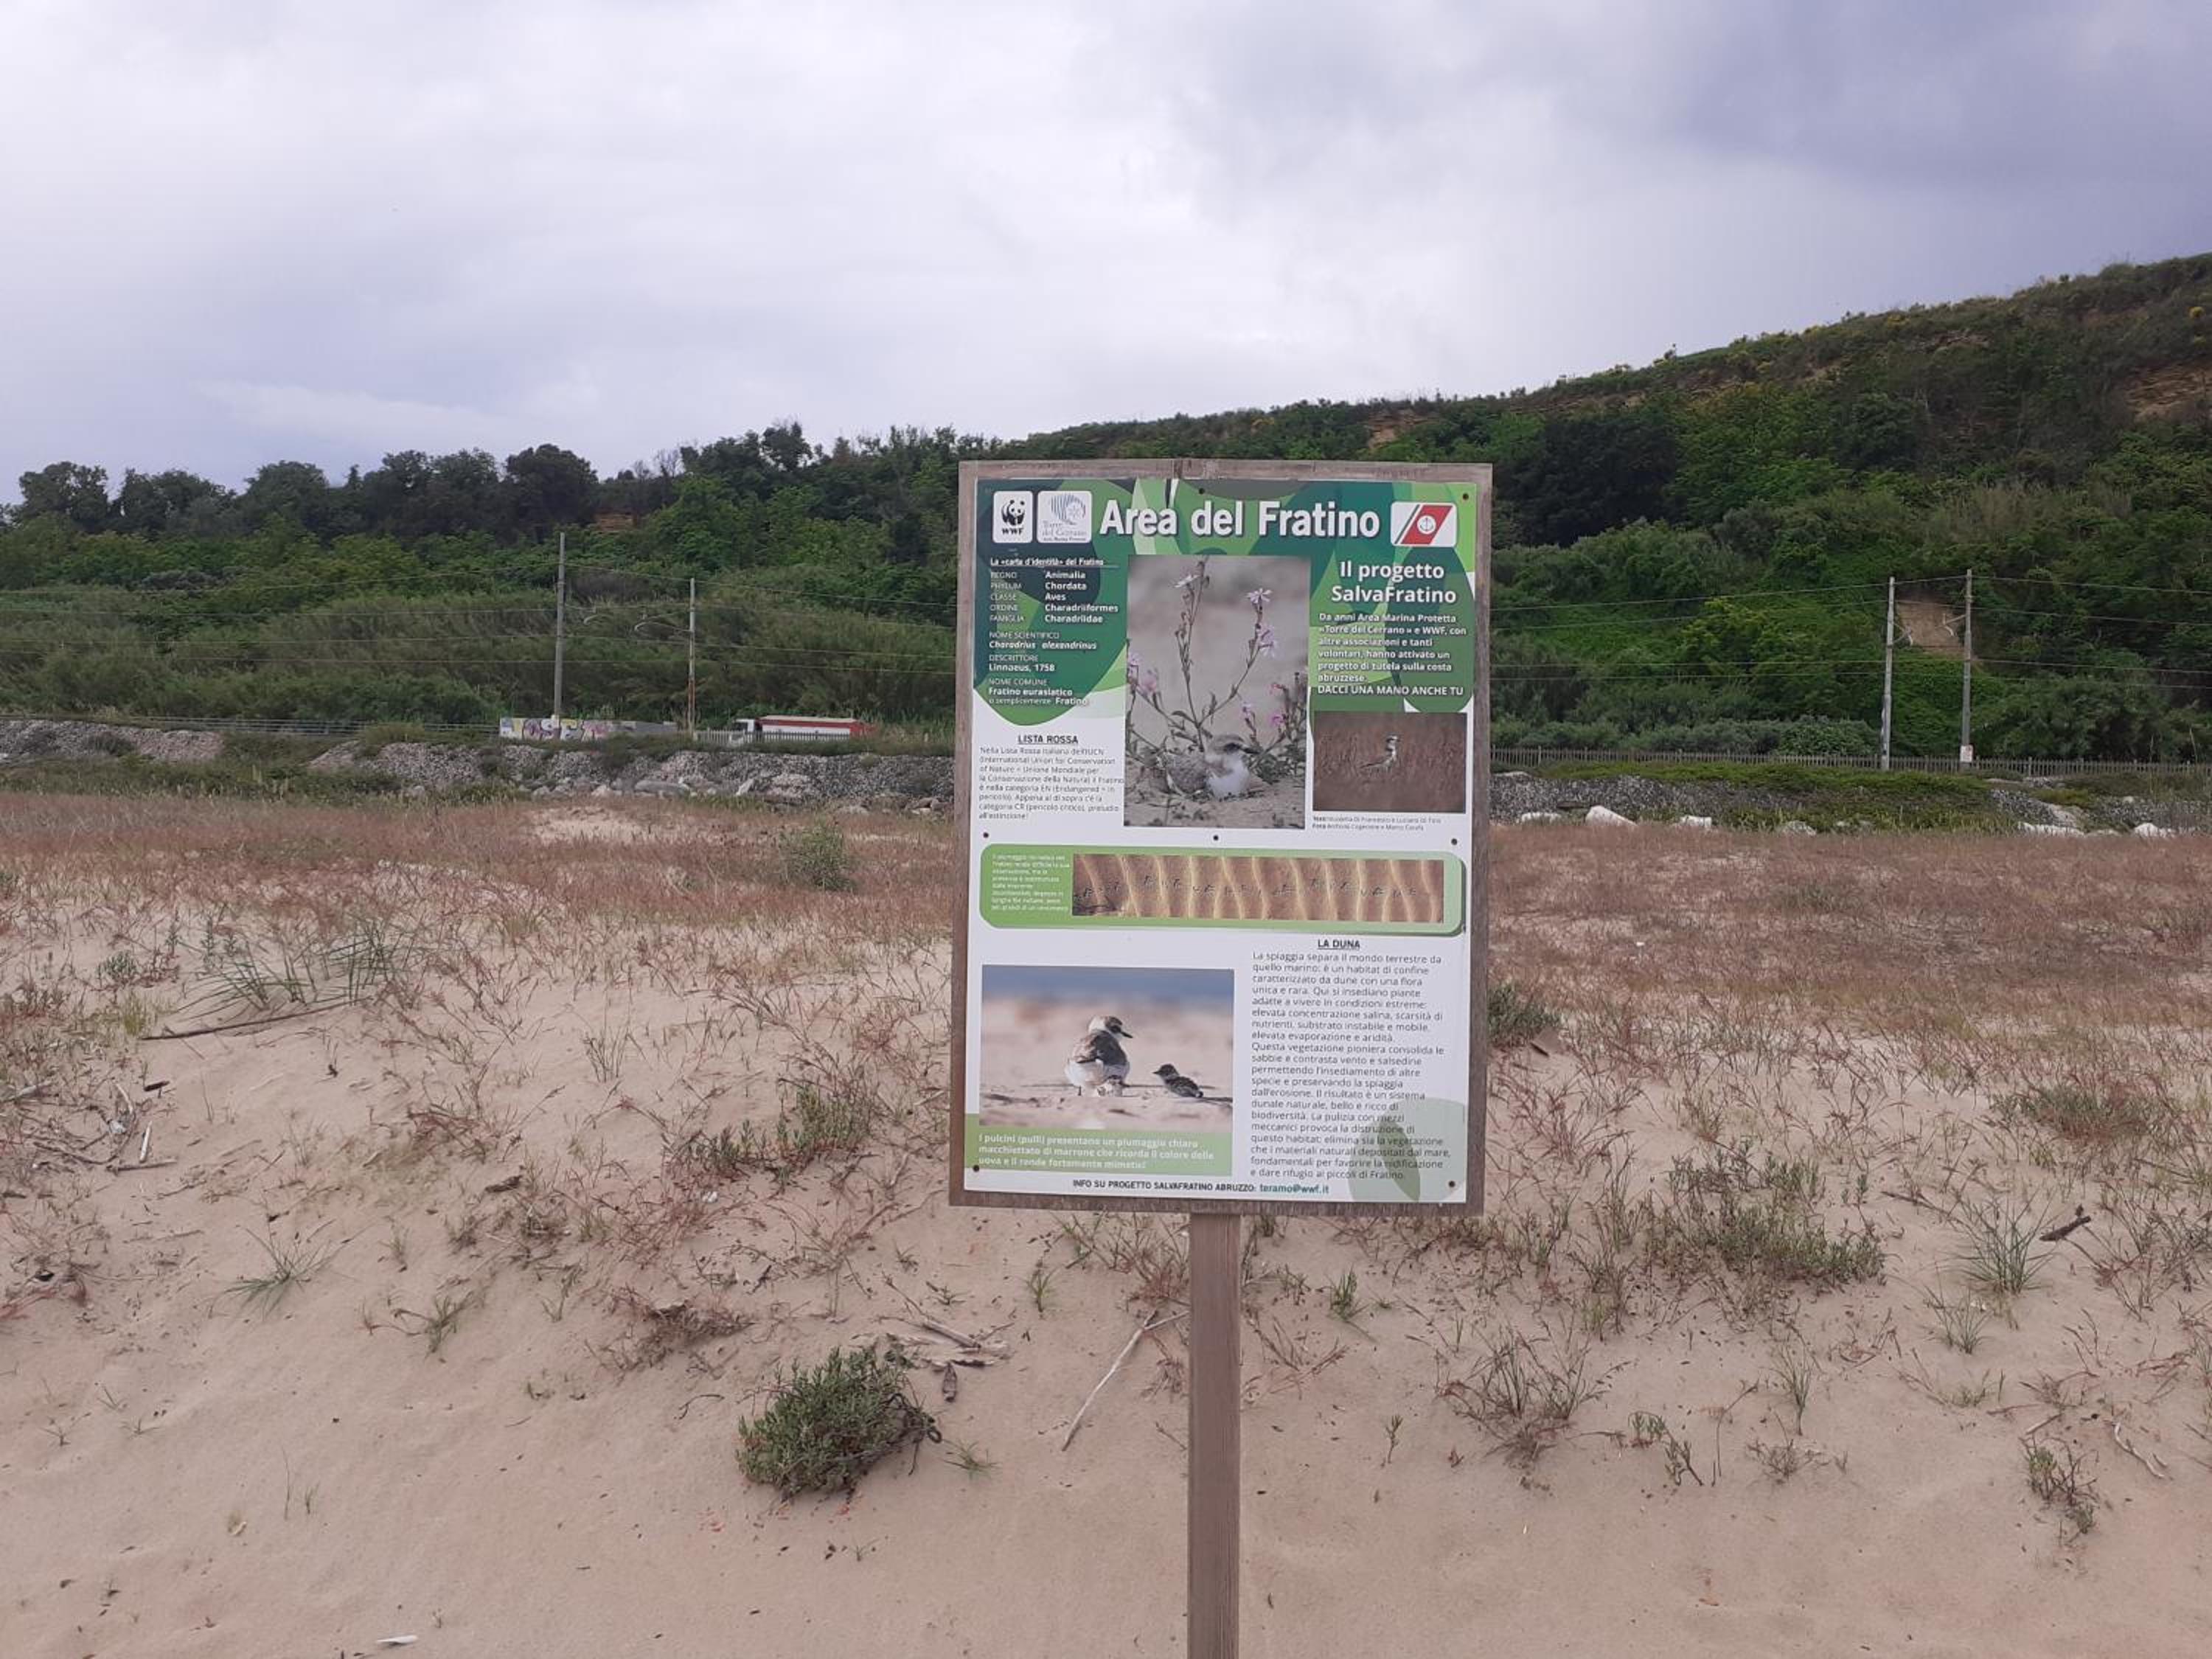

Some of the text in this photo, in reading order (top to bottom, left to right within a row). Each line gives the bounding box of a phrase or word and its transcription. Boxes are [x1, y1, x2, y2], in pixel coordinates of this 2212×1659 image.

[1100, 500, 1380, 538] Area del Fratino
[1045, 571, 1086, 579] Animalia
[1340, 560, 1444, 583] Il progetto
[1332, 585, 1456, 602] SalvaFratino
[1045, 604, 1119, 612] Charadriiformes
[1045, 614, 1103, 622] Charadriidae
[1334, 613, 1355, 622] anni
[1381, 614, 1415, 622] Marina
[1319, 637, 1341, 645] altre
[1343, 637, 1399, 646] associazioni
[1409, 638, 1433, 646] tanti
[1318, 649, 1364, 658] volontari,
[1366, 650, 1396, 658] hanno
[1397, 650, 1435, 658] attivato
[989, 663, 1032, 672] Linnaeus,
[1318, 662, 1358, 672] progetto
[1360, 662, 1369, 670] di
[1371, 662, 1400, 670] tutela
[1402, 663, 1425, 671] sulla
[989, 687, 1072, 696] Fratino eurasiatico
[1318, 685, 1463, 695] DACCI UNA MANO ANCHE TU
[1055, 697, 1087, 705] Fratino
[1018, 735, 1079, 744] LISTA ROSSA
[1332, 940, 1360, 948] DUNA
[1107, 1181, 1151, 1189] PROGETTO
[1152, 1183, 1214, 1191] SALVAFRATINO
[1260, 1184, 1329, 1194] teramo@wwf.it
